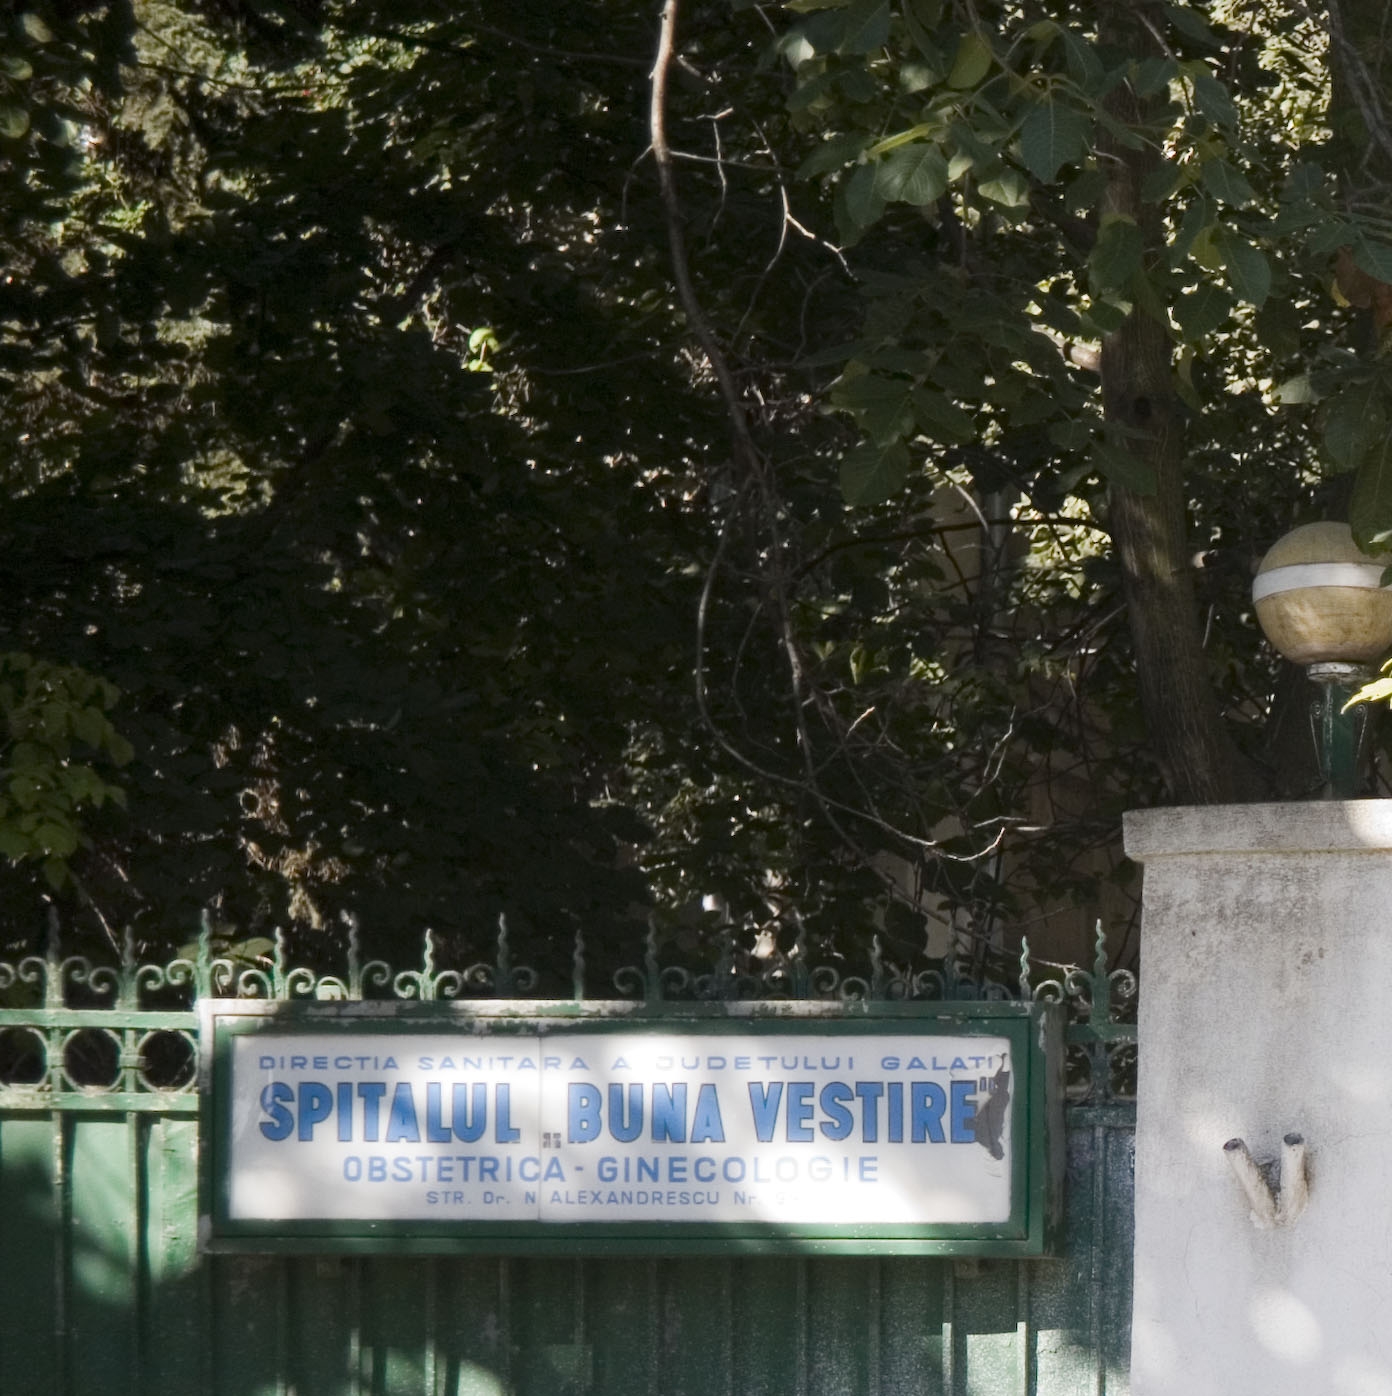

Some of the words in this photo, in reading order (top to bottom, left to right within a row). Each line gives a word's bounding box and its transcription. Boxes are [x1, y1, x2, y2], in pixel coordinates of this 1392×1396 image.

[259, 1055, 400, 1070] DIRECTIA
[417, 1056, 591, 1071] SANITARA
[610, 1056, 632, 1071] A
[655, 1056, 854, 1071] JUDETULUI
[880, 1055, 994, 1071] GALATI
[258, 1081, 522, 1144] SPITALUL
[343, 1155, 567, 1183] OBSTETRICA
[596, 1155, 879, 1184] GINECOLOGIE
[425, 1190, 473, 1205] STR.
[483, 1190, 511, 1205] Dr.
[551, 1189, 721, 1206] ALEXANDRESCU
